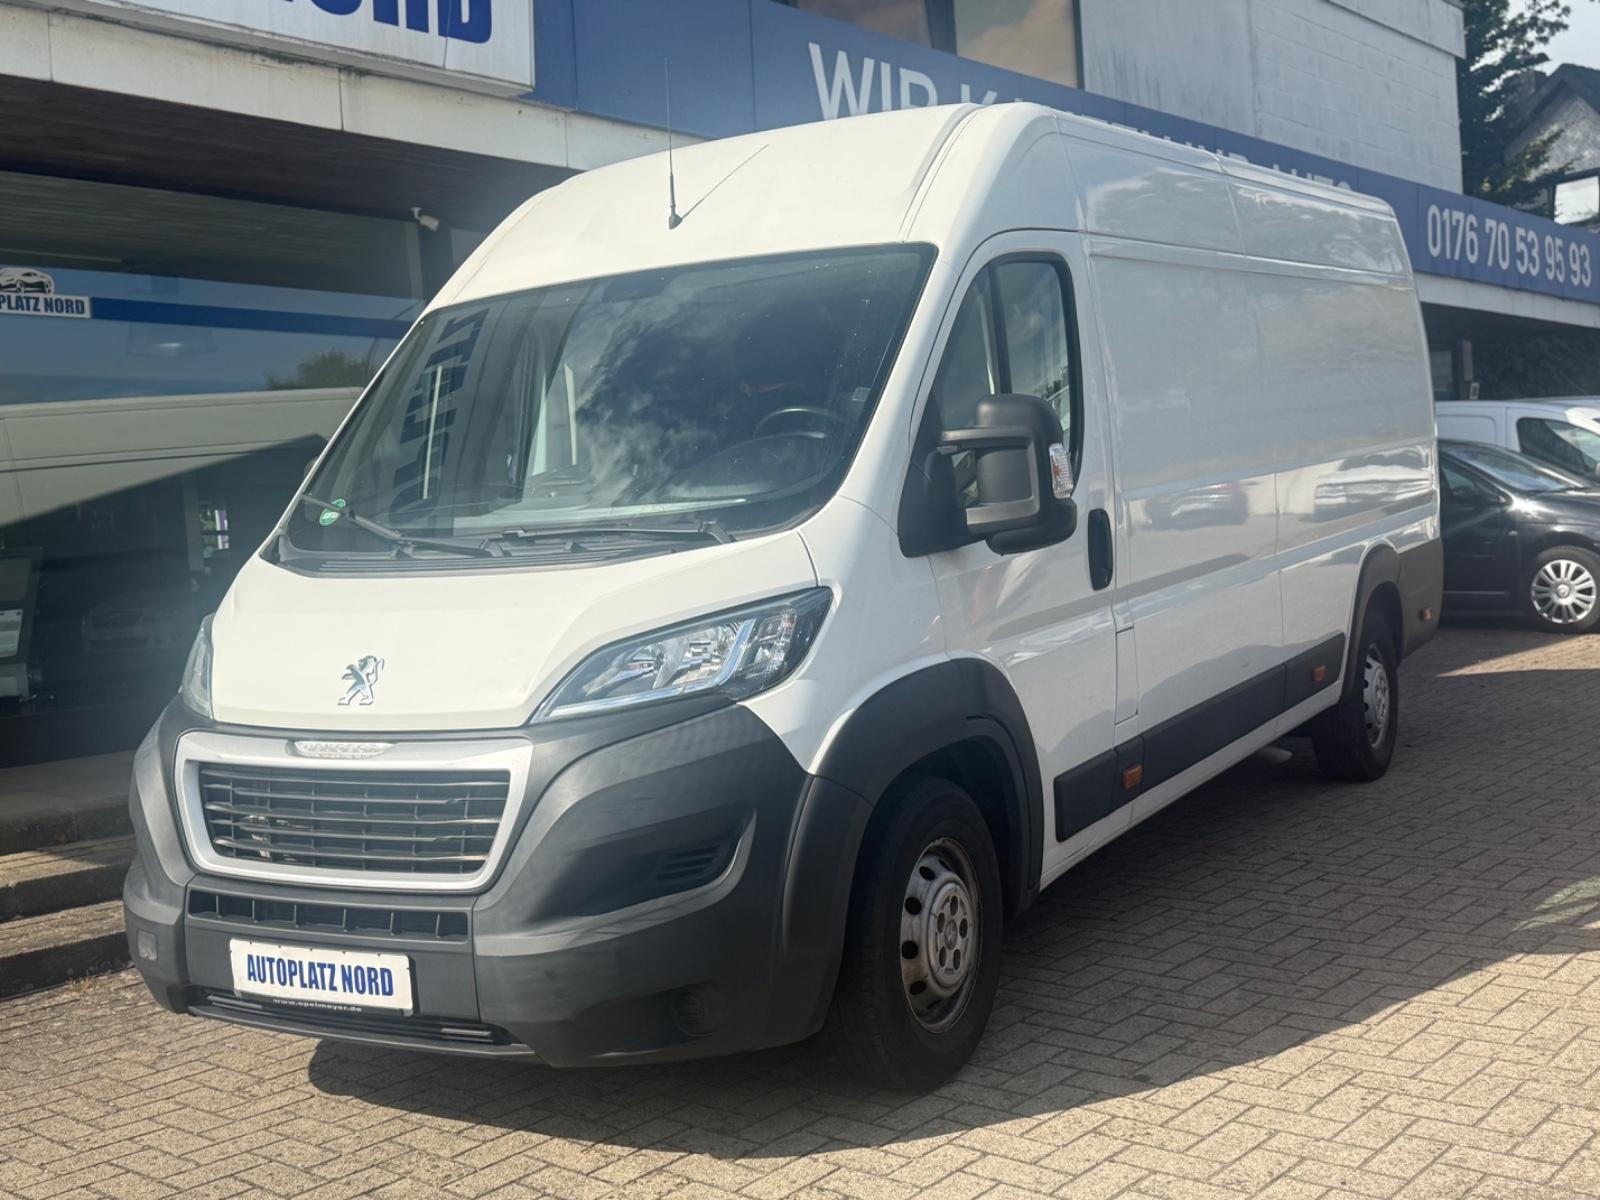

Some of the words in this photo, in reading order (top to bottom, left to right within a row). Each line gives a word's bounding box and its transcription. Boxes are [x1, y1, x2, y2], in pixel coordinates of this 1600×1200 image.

[1427, 204, 1479, 265] 0176
[1484, 218, 1510, 271] 70
[1515, 226, 1540, 277] 53
[1544, 234, 1566, 283] 95
[1569, 242, 1592, 288] 93
[44, 297, 85, 315] NORD
[246, 953, 338, 993] AUTOPLATZ
[341, 964, 394, 997] NORD
